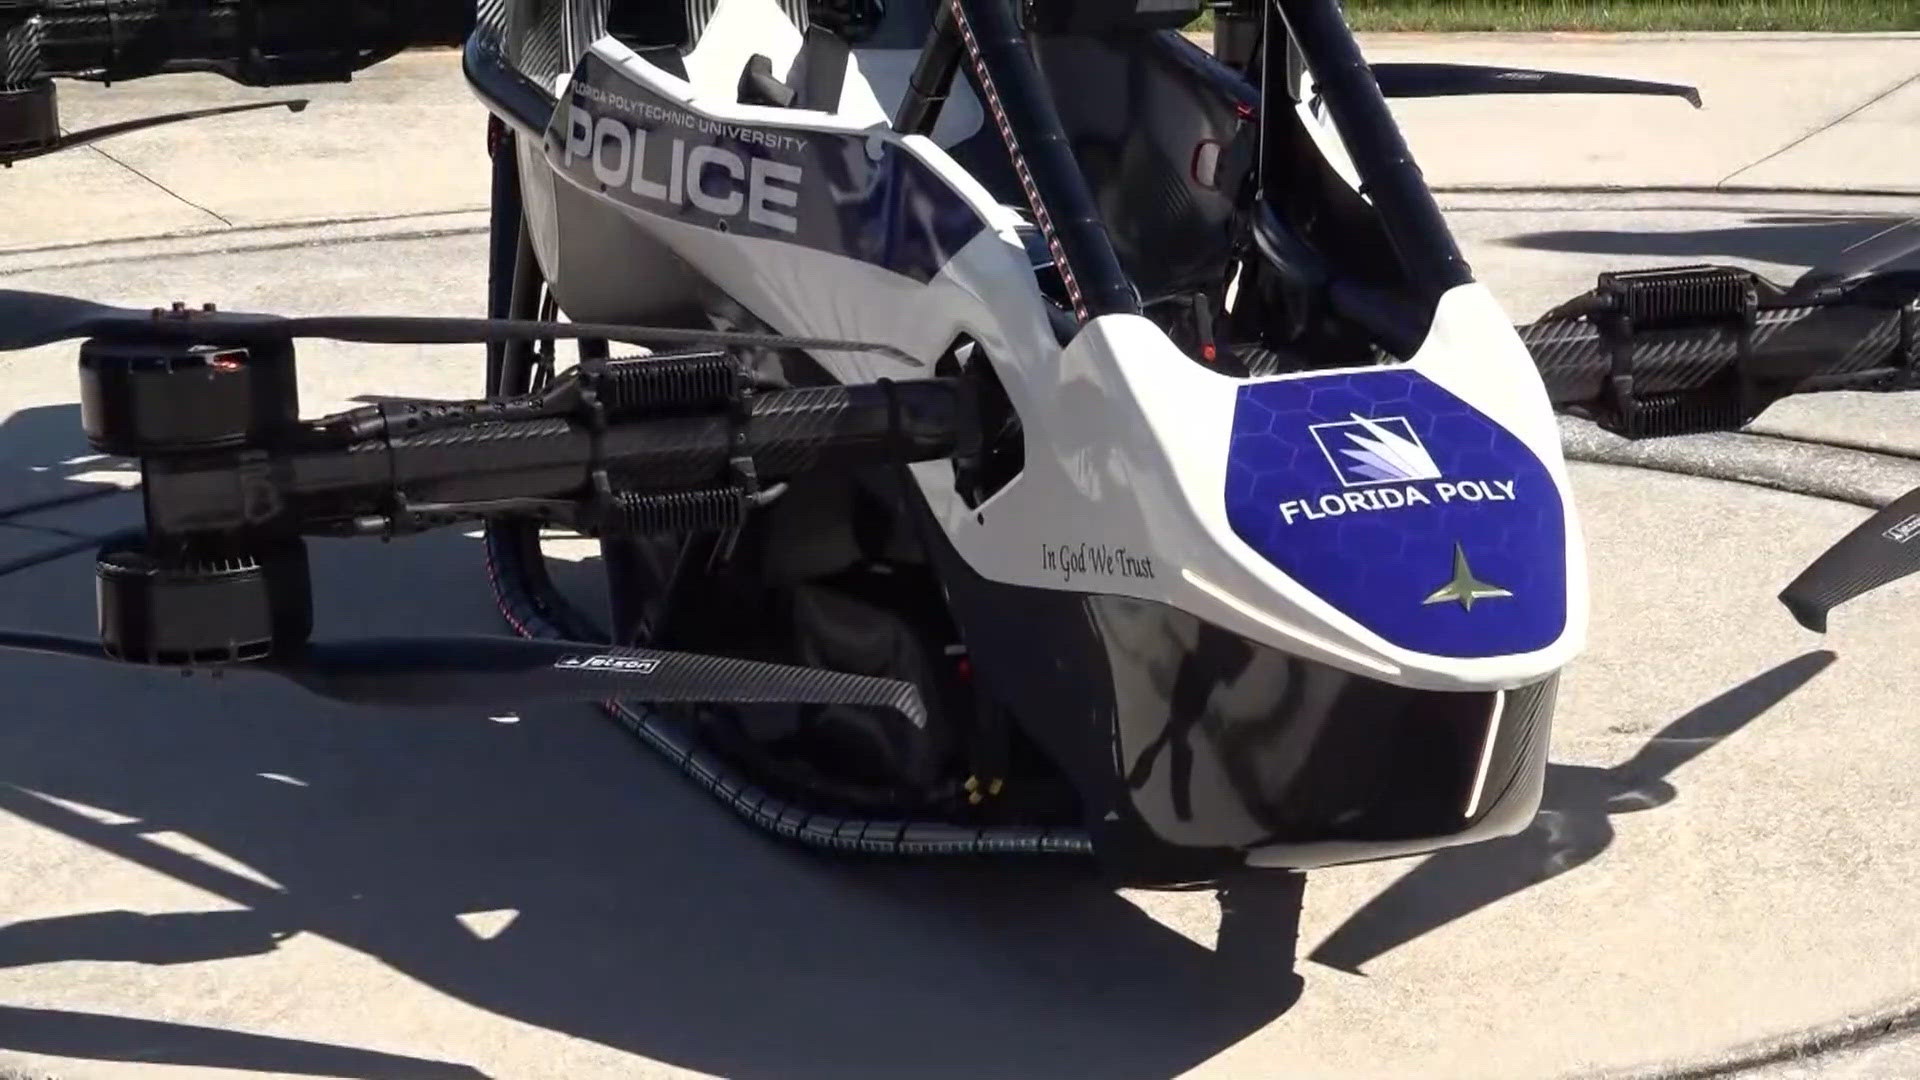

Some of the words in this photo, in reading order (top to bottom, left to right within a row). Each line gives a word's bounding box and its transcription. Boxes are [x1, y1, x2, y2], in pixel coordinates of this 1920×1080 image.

[608, 94, 695, 129] POLYTECHNIC
[699, 118, 808, 152] UNIVERSITY
[564, 104, 802, 234] POLICE
[1279, 486, 1430, 526] FLORIDA
[1434, 479, 1516, 504] POLY
[1042, 543, 1056, 570] In
[1059, 542, 1086, 582] God
[1088, 544, 1114, 575] We
[1115, 547, 1154, 579] Trust
